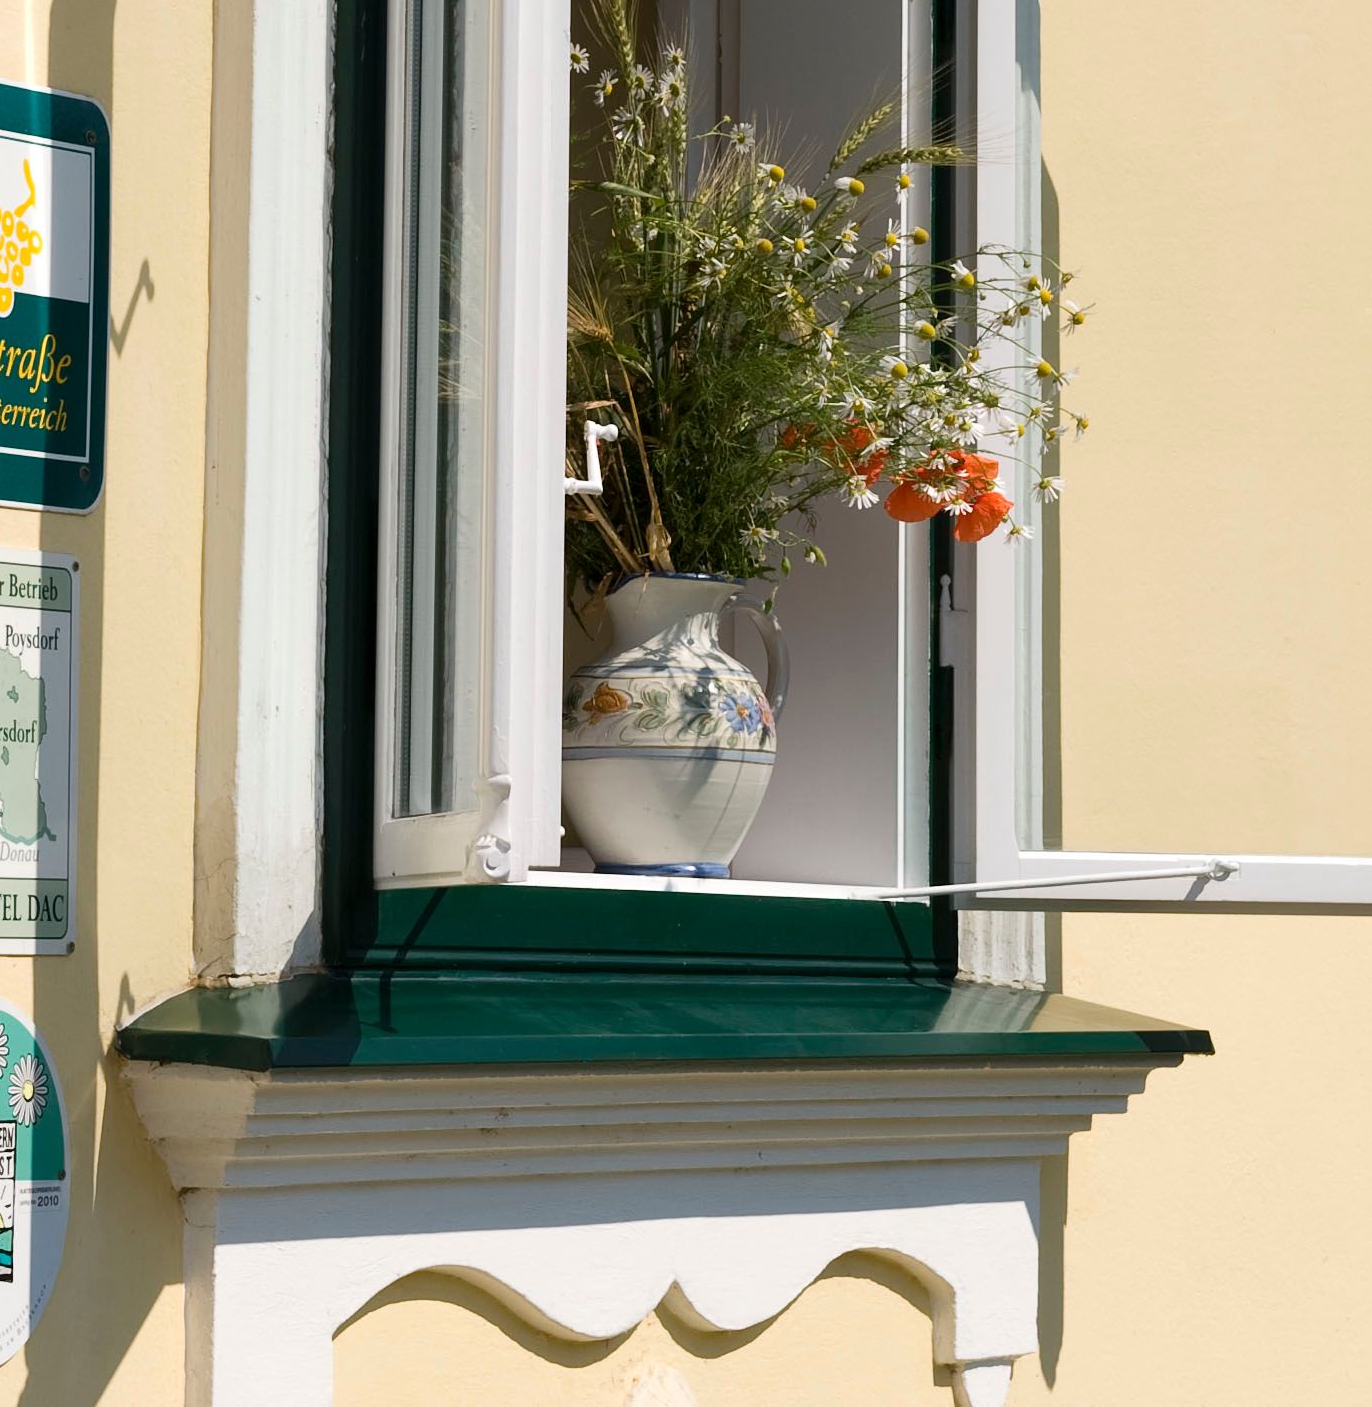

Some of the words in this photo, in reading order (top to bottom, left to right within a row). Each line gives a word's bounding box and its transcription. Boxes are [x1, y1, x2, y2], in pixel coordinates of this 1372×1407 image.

[9, 573, 59, 601] Betrieb
[5, 624, 61, 656] Poysdorf
[0, 840, 39, 863] Donau
[27, 894, 65, 922] DAC
[37, 1194, 59, 1207] 2010
